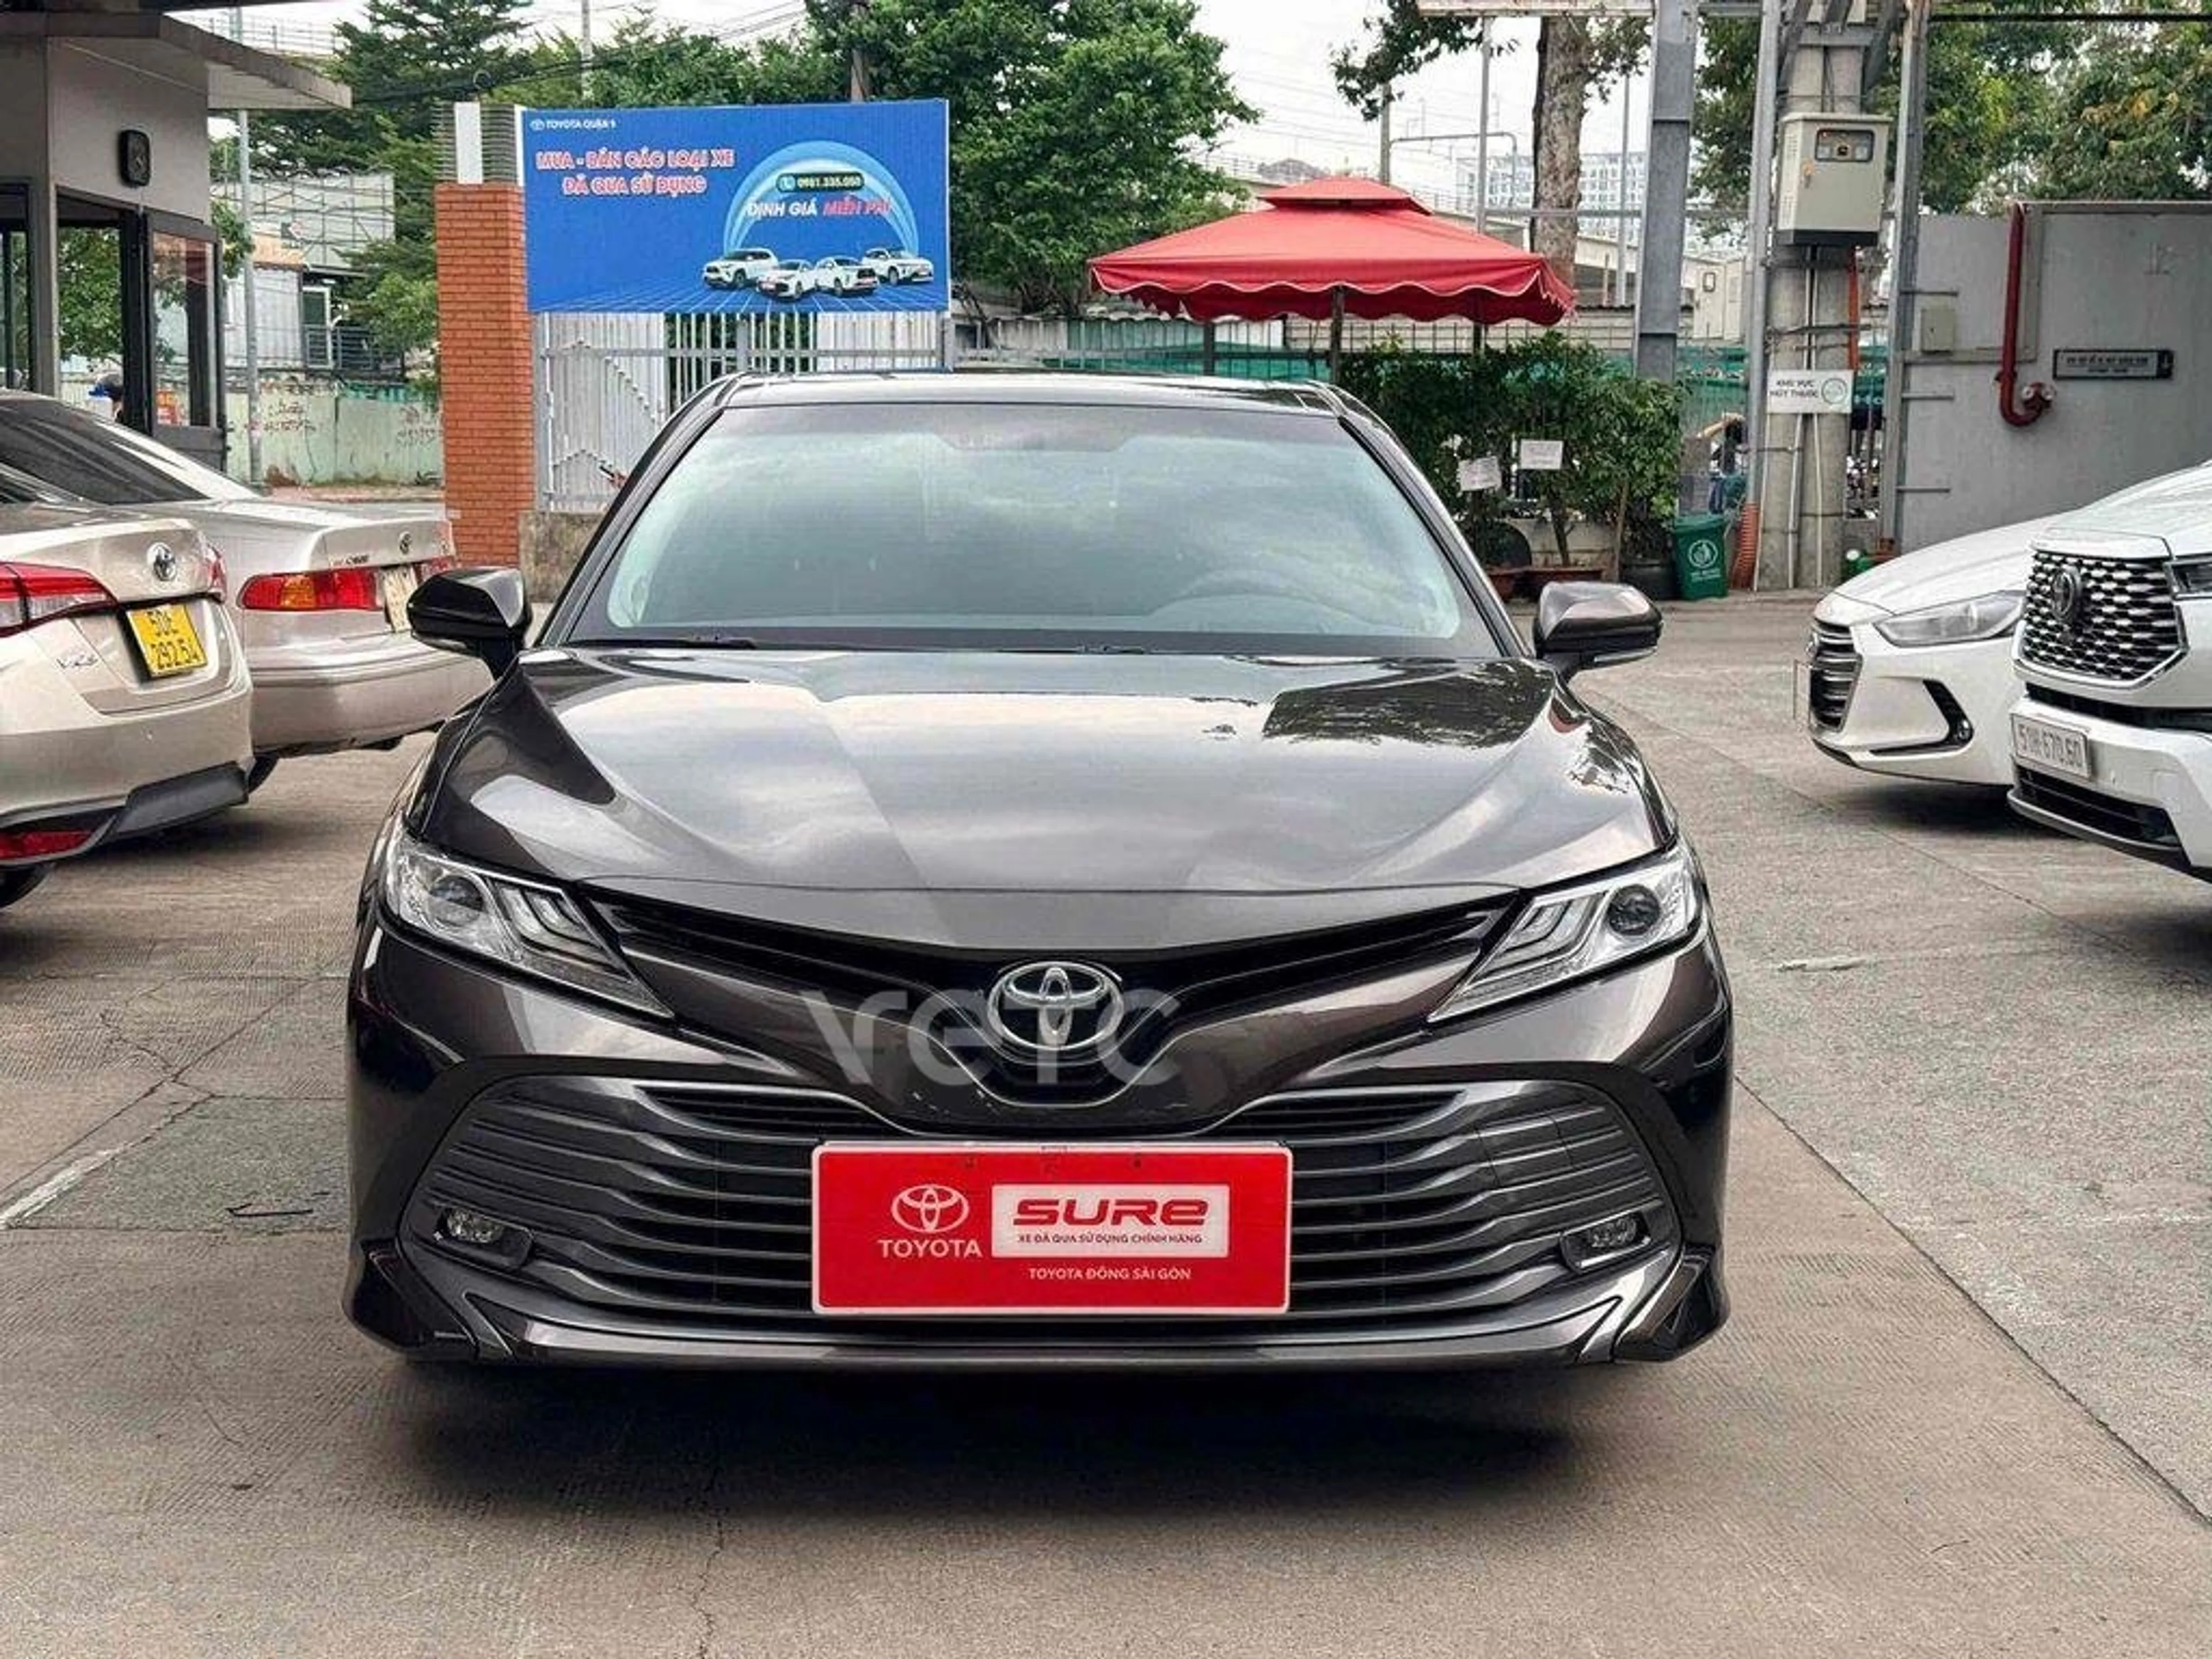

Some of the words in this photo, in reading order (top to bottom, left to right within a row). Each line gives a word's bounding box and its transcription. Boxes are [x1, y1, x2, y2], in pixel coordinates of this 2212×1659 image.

[547, 118, 582, 130] TOYOTA
[536, 151, 575, 170] MUA
[585, 146, 623, 170] BÁN
[624, 145, 666, 169] CÁC
[666, 149, 709, 172] LOẠI
[710, 148, 735, 167] XE
[590, 176, 629, 195] QUA
[656, 175, 707, 198] DỤNG
[747, 201, 786, 219] ĐỊNH
[788, 197, 818, 217] GIÁ
[1018, 1233, 1032, 1243] XE
[1051, 1234, 1076, 1244] QUA
[877, 1239, 983, 1259] TOYOTA
[1028, 1268, 1083, 1280] TOYOTA
